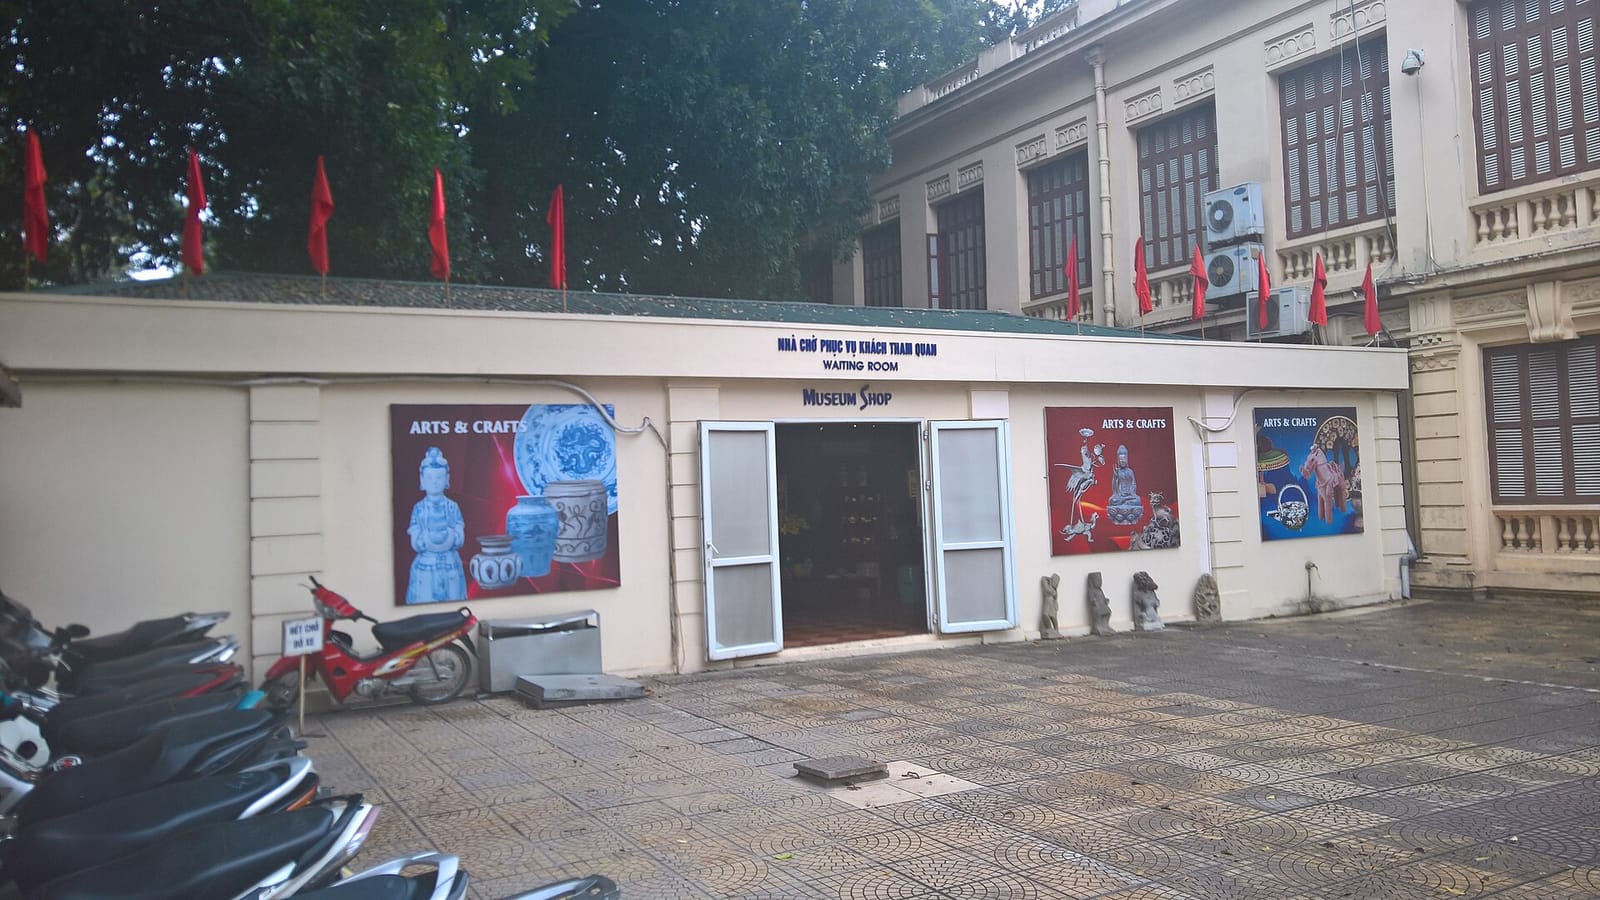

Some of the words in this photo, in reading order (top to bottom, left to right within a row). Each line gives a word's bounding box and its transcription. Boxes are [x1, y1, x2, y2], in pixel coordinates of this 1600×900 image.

[820, 338, 843, 357] PHỤC
[845, 340, 857, 358] VỤ
[859, 338, 887, 355] KHÁCH
[889, 342, 913, 356] THAM
[914, 343, 937, 357] QUAN
[823, 359, 864, 372] WAITING
[867, 361, 899, 372] ROOM
[409, 420, 450, 434] ARTS
[454, 420, 468, 434] &
[472, 419, 528, 434] CRAFTS
[1102, 418, 1124, 429] ARTS
[1126, 418, 1135, 428] &
[1135, 418, 1166, 428] CRAFTS
[1263, 418, 1282, 428] ARTS
[1283, 418, 1290, 427] &
[1291, 417, 1317, 427] CRAFTS
